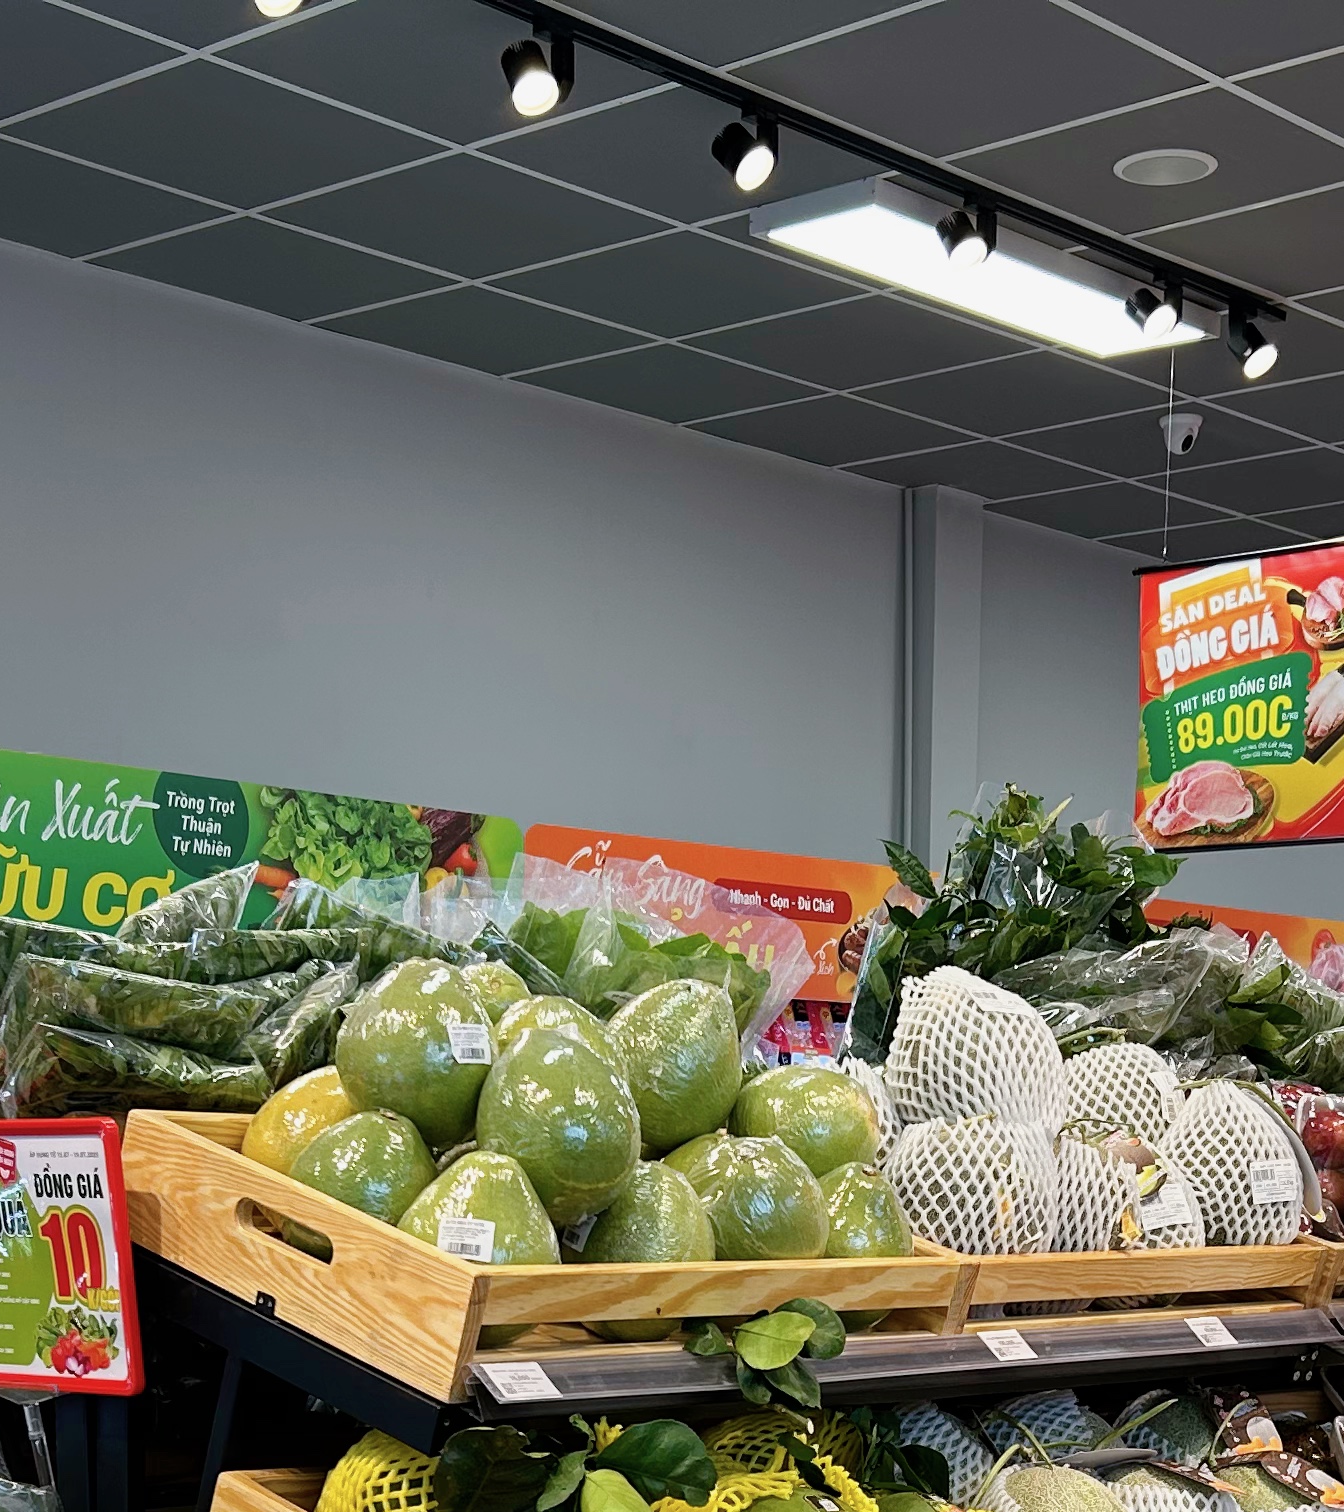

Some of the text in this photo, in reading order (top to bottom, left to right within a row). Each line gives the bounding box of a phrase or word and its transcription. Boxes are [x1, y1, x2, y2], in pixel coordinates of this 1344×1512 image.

[1208, 580, 1267, 616] DEAL
[1155, 604, 1279, 682] ĐỒNG GIÁ
[1174, 696, 1199, 716] THỊT
[1202, 687, 1225, 708] HEO
[1269, 668, 1292, 691] GIÁ
[41, 778, 161, 847] Xuất
[167, 789, 236, 818] Trồng Trọt
[181, 814, 222, 837] Thuận
[172, 835, 232, 859] Tự Nhiên
[729, 889, 762, 907] Nhanh
[770, 891, 790, 910] Gọn
[797, 895, 811, 912] Đủ
[812, 895, 835, 914] Chất
[33, 1163, 104, 1199] ĐỒNG GIÁ
[39, 1208, 103, 1299] 10
